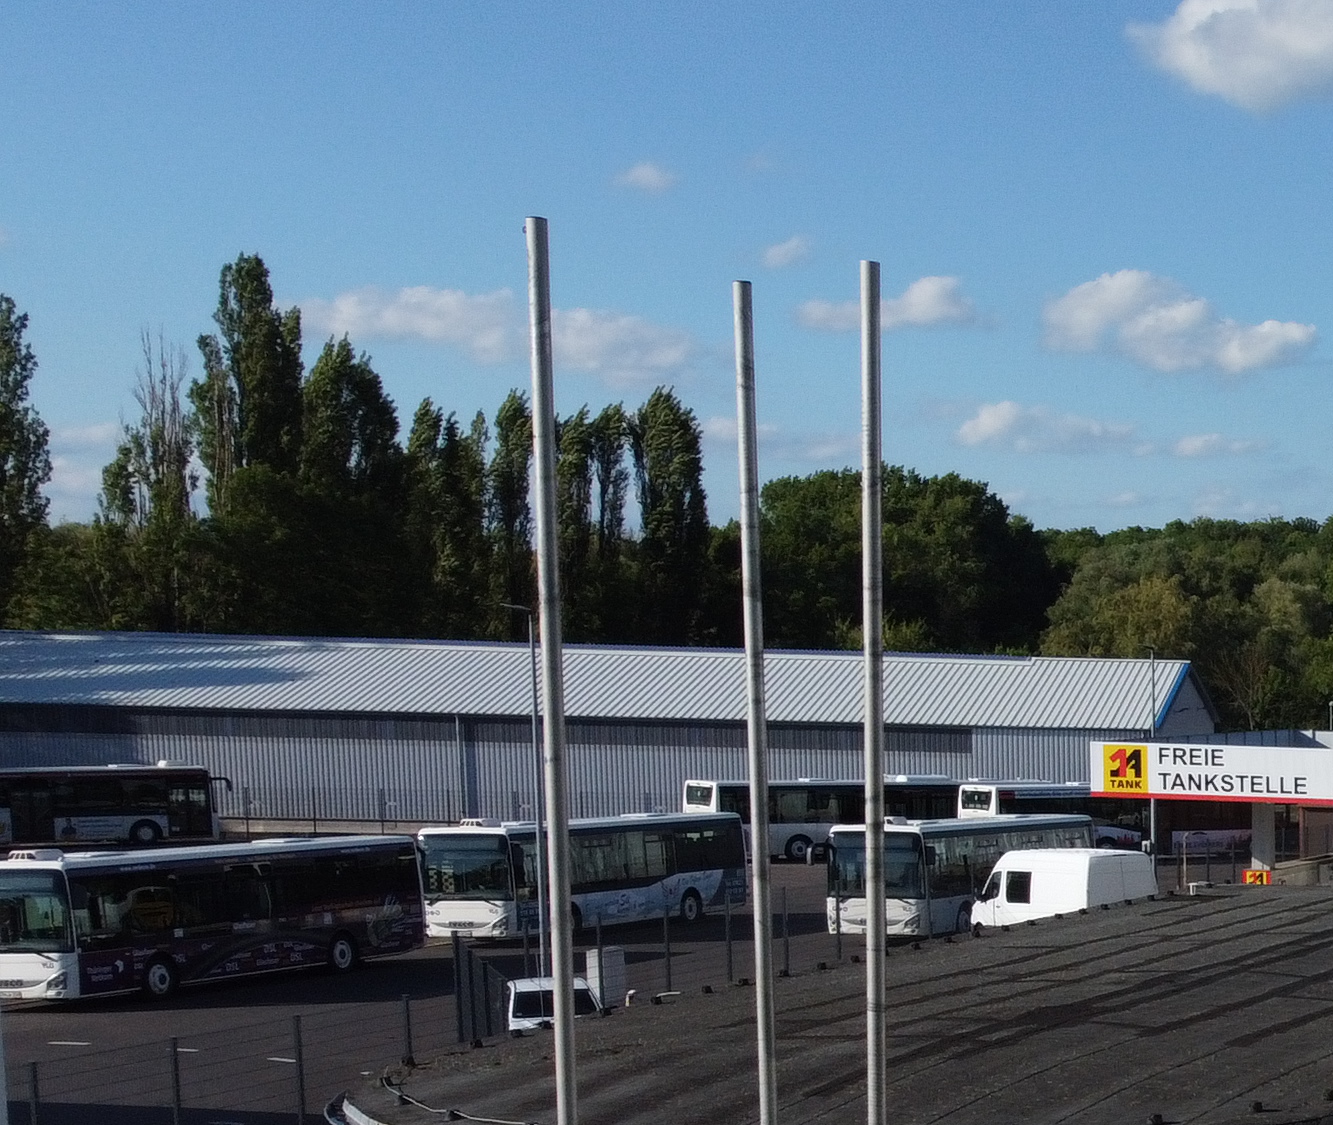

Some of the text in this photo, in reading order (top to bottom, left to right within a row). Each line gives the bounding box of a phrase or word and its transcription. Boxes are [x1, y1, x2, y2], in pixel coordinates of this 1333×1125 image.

[1158, 747, 1225, 768] FREIE
[1110, 780, 1142, 789] TANK
[1158, 773, 1308, 796] TANKSTELLE
